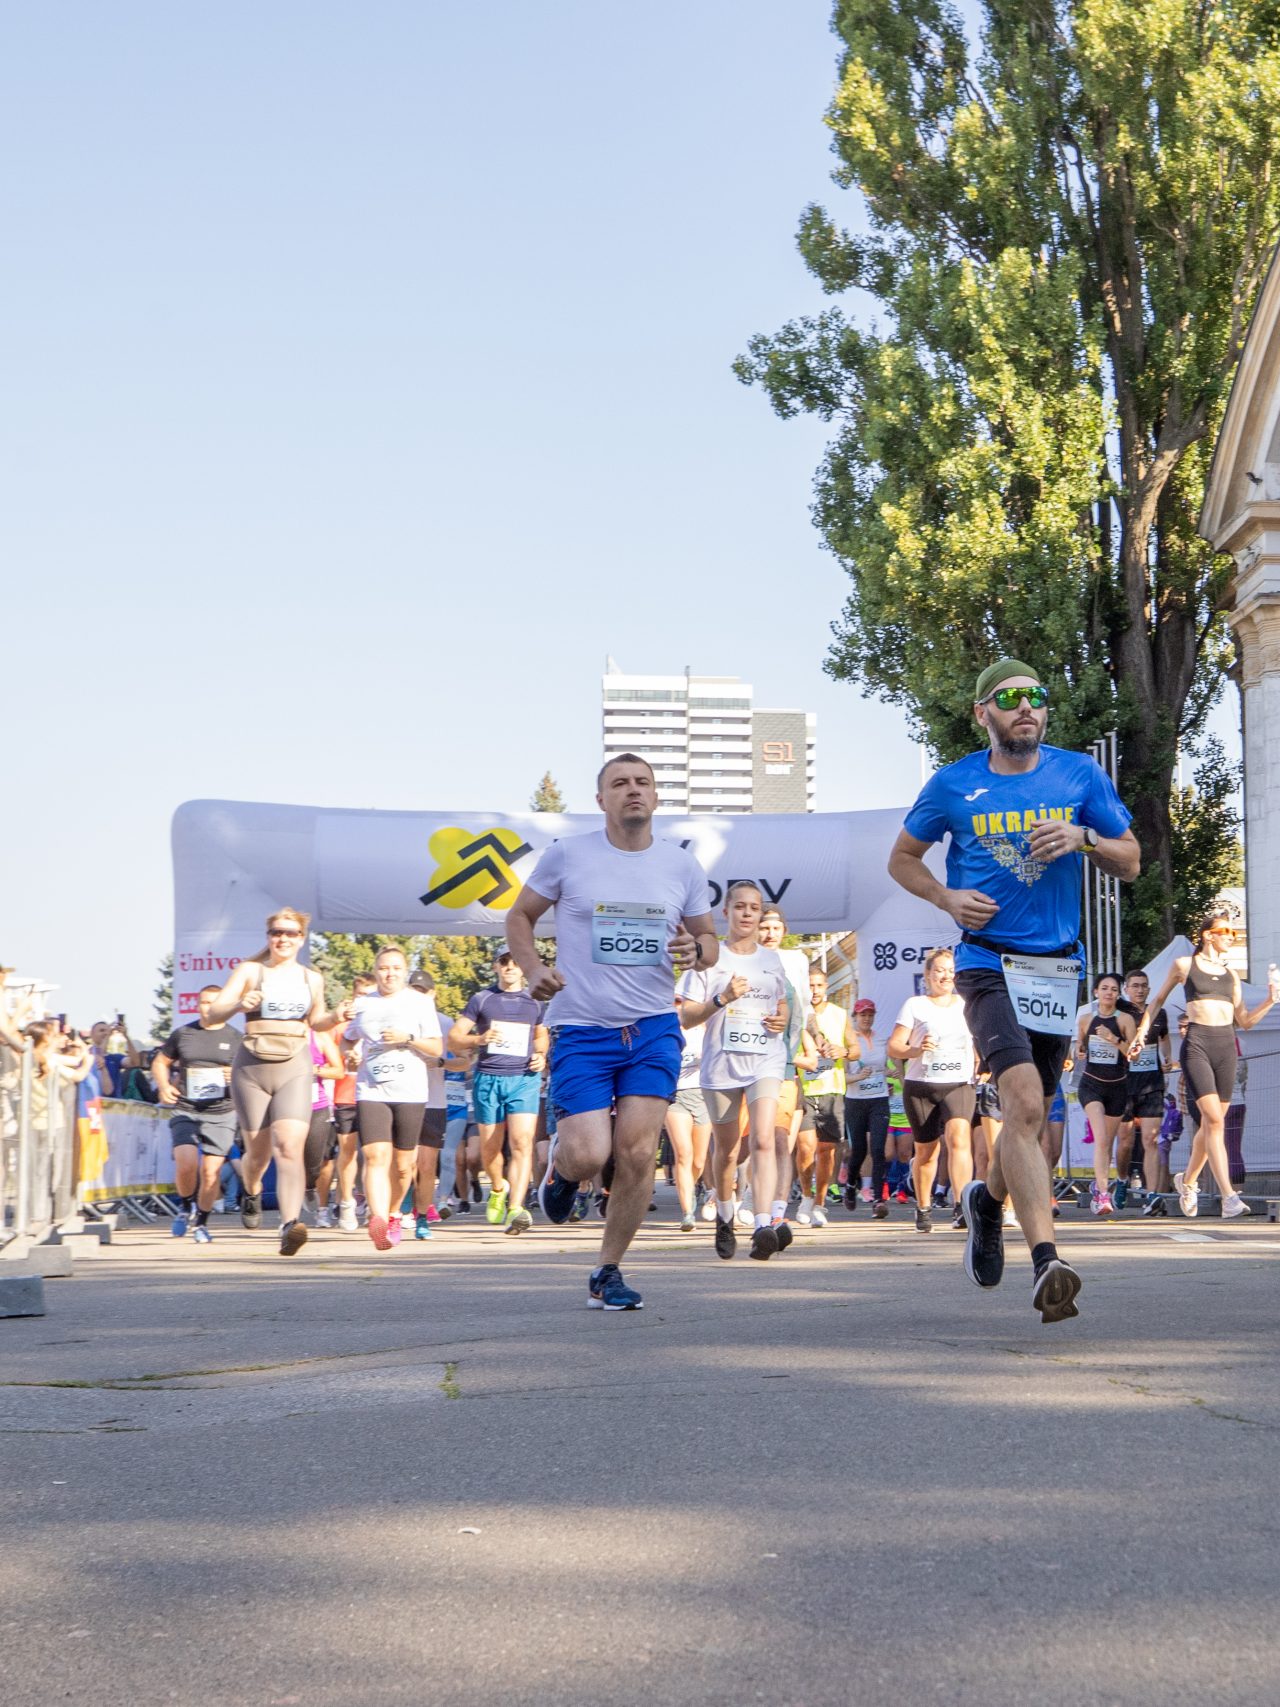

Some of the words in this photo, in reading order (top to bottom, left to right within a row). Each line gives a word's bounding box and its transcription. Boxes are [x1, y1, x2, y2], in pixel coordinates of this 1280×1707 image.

[763, 742, 797, 763] S1
[600, 937, 658, 953] 5025
[179, 952, 244, 971] Unive
[1017, 996, 1067, 1020] 5014
[729, 1031, 767, 1045] 5070
